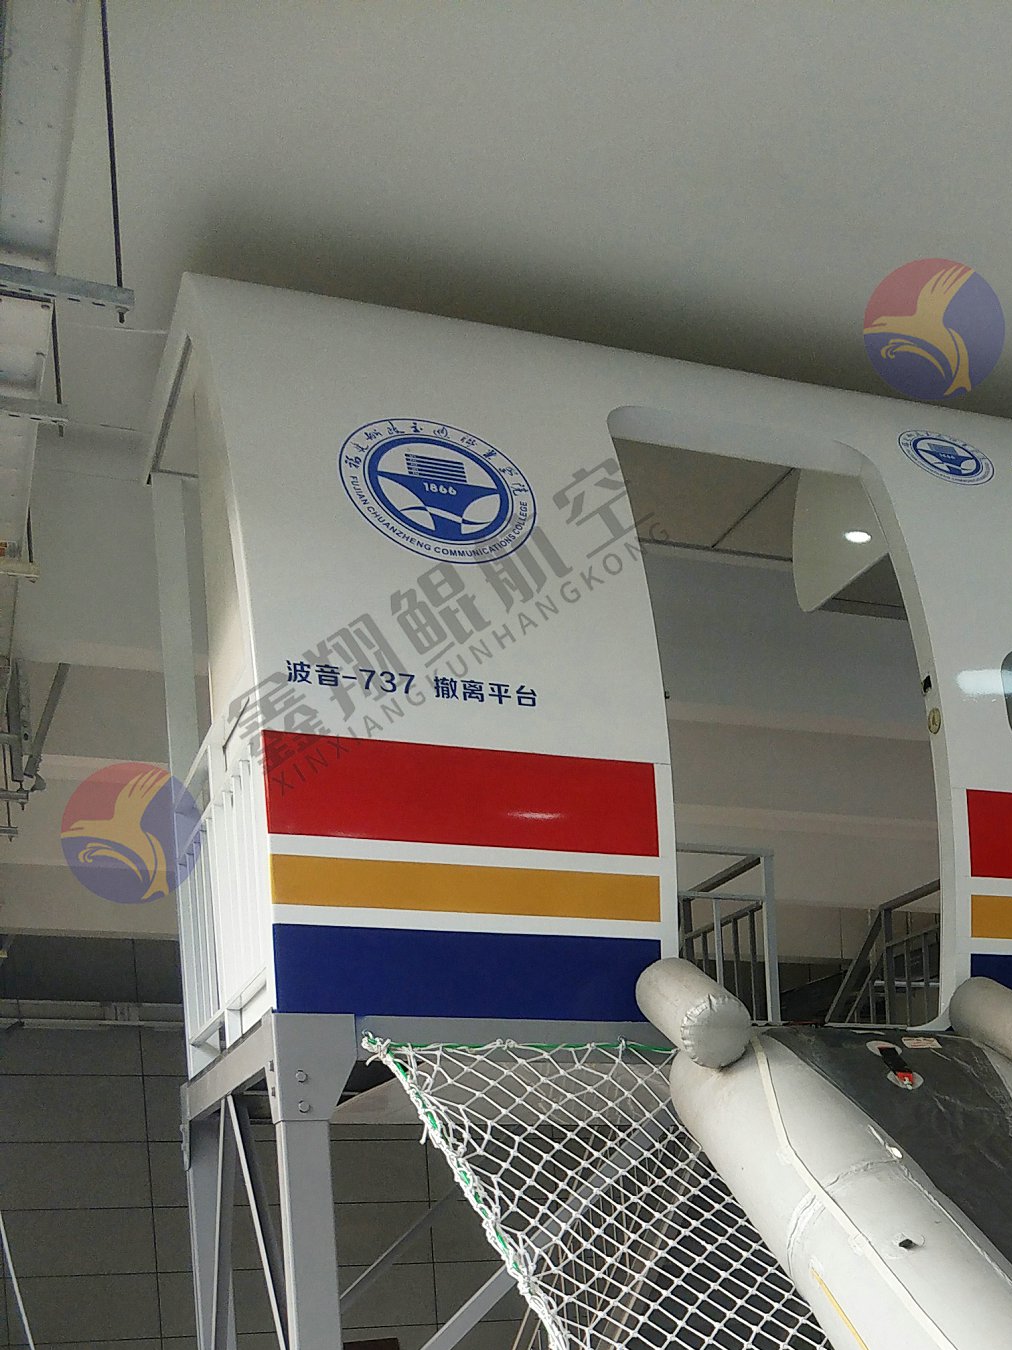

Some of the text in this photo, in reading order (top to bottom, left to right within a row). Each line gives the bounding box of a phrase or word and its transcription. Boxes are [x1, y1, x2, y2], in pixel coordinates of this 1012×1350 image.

[423, 481, 458, 496] 1866
[349, 475, 529, 558] FUJIAN CHUANZHENG COMMUNICATIONS COLLEGE
[286, 659, 538, 708] 波音-737 撤离平台
